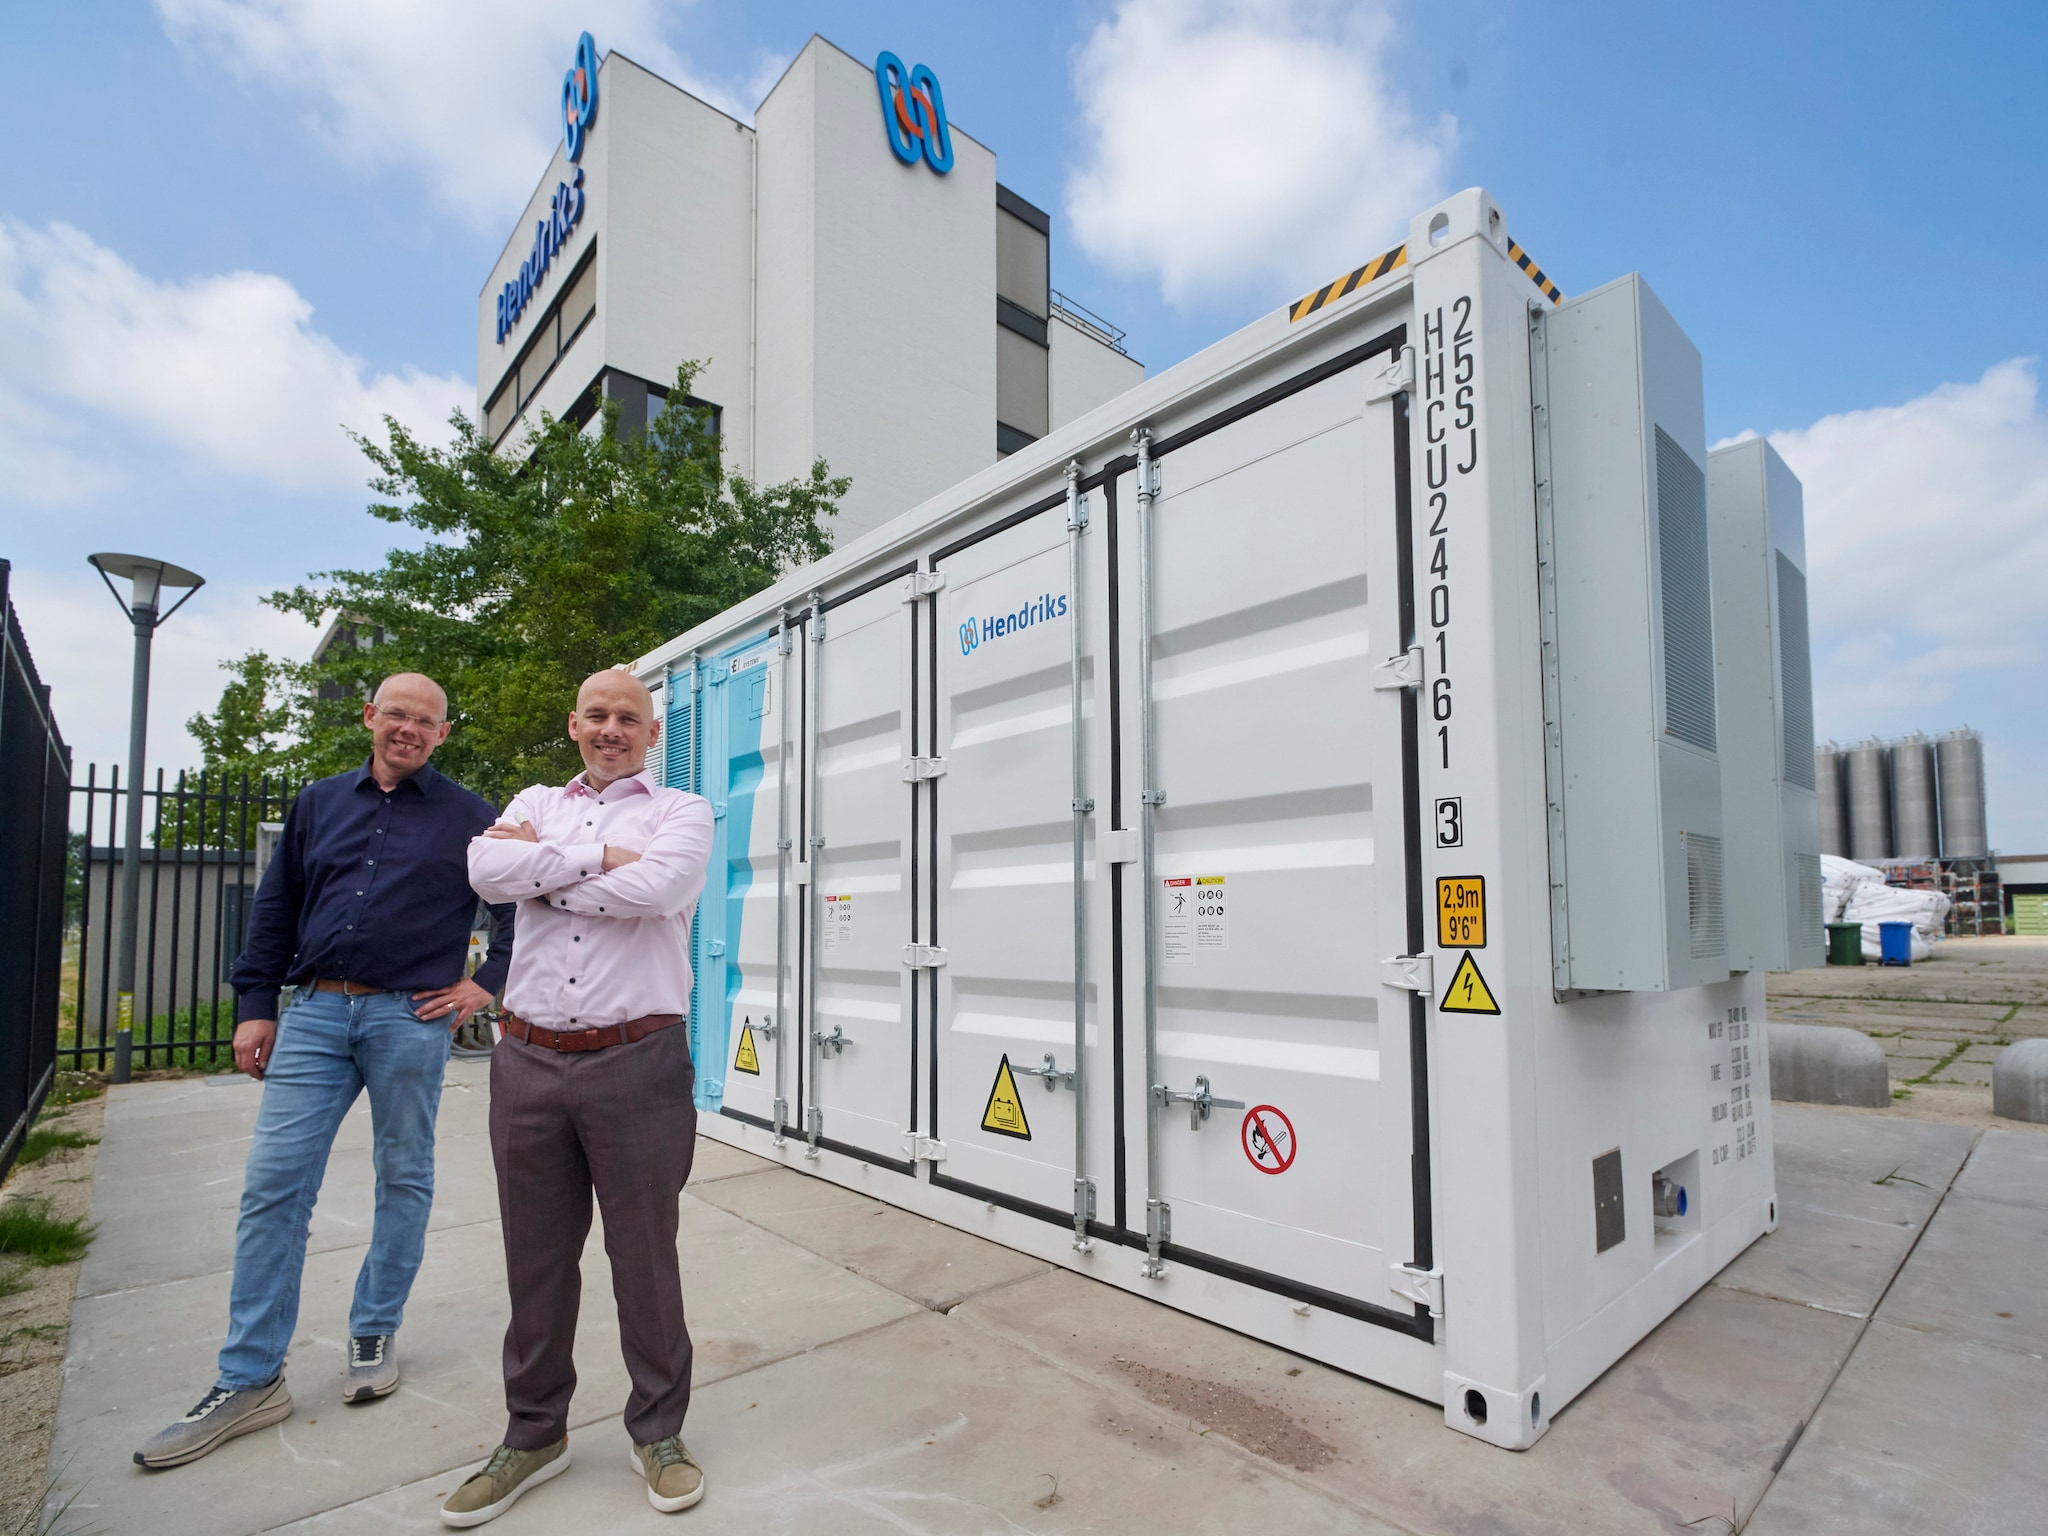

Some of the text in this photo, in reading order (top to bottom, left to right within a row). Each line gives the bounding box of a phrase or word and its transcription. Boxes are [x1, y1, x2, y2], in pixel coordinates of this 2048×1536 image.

[496, 167, 585, 345] Hendriks
[1453, 295, 1478, 475] 25SJ
[982, 592, 1068, 642] Hendriks
[1438, 801, 1459, 845] 3
[1443, 884, 1479, 912] 2,9m
[1449, 915, 1477, 940] 9'6"
